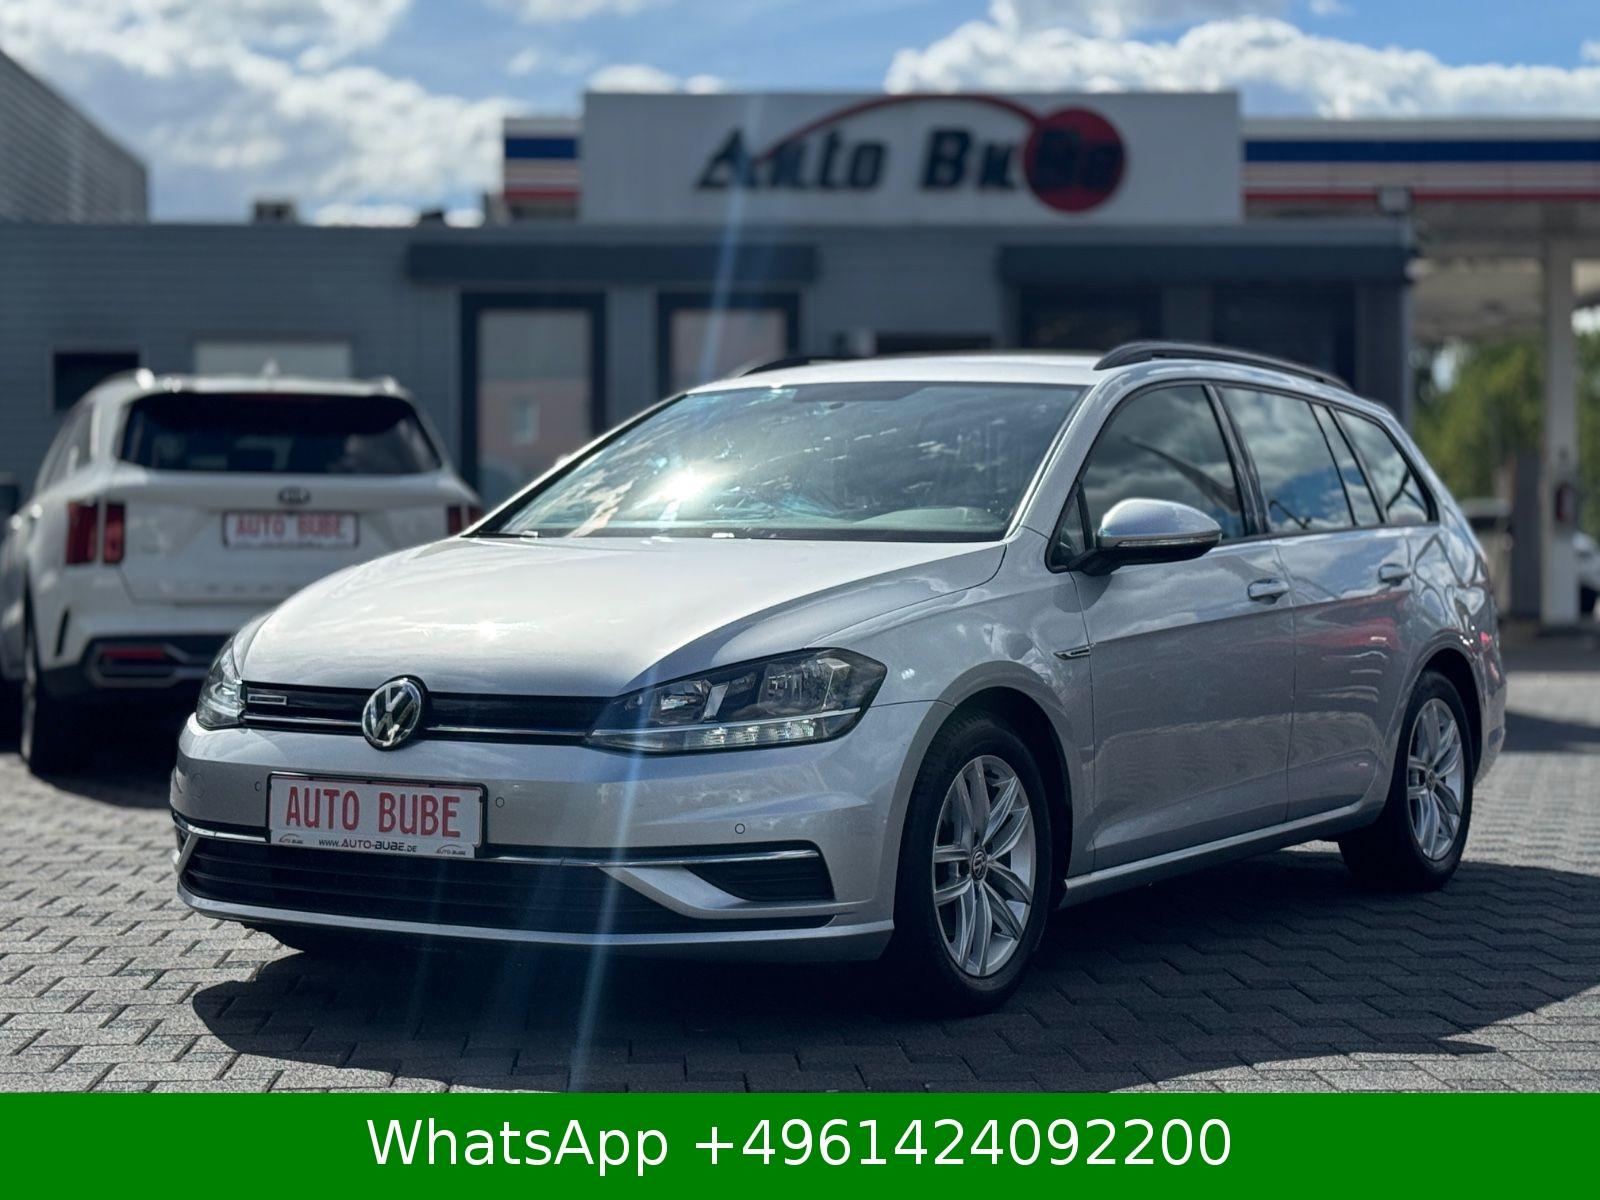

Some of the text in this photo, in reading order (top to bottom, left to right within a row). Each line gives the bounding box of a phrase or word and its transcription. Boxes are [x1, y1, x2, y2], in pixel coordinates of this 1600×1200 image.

[696, 128, 886, 191] Auto
[236, 513, 286, 535] AUTO
[286, 786, 461, 838] AUTO BUBE
